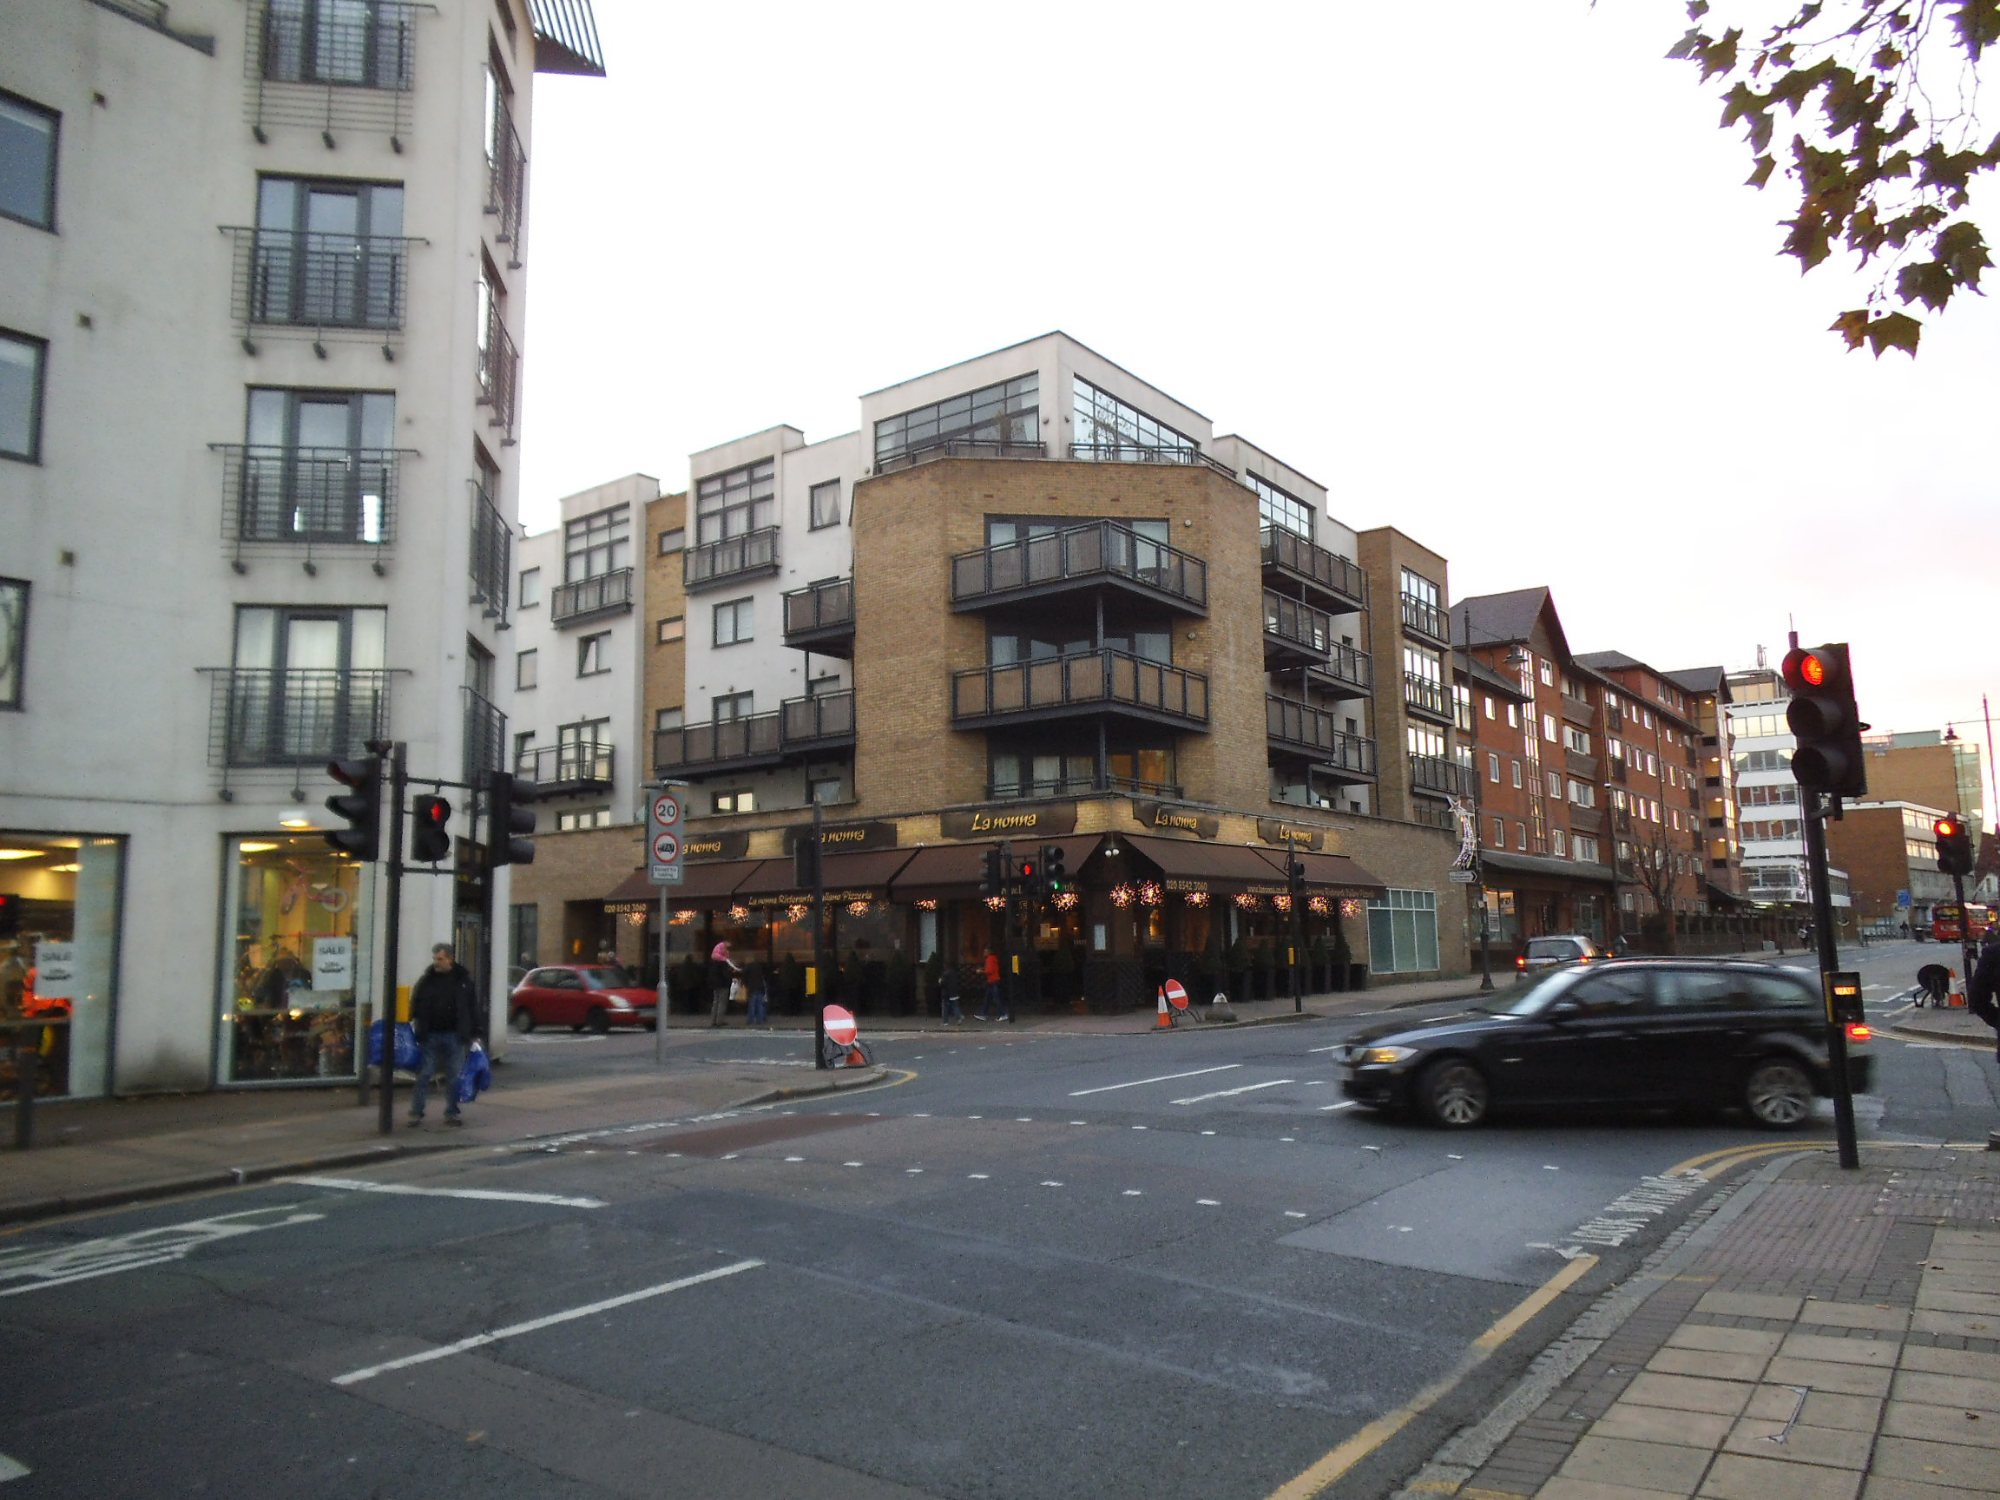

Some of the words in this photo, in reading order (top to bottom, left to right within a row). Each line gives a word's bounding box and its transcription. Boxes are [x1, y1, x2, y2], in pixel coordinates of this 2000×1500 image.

[658, 804, 676, 818] 20
[972, 813, 990, 831] La
[993, 813, 1037, 829] nonna
[1155, 808, 1168, 826] La
[1169, 815, 1197, 828] nonna
[828, 829, 865, 842] nonna
[1279, 824, 1290, 839] La
[690, 841, 721, 854] nonna
[1166, 880, 1178, 890] 020
[604, 904, 616, 913] 020
[42, 952, 72, 962] SALE
[319, 946, 345, 955] SALE
